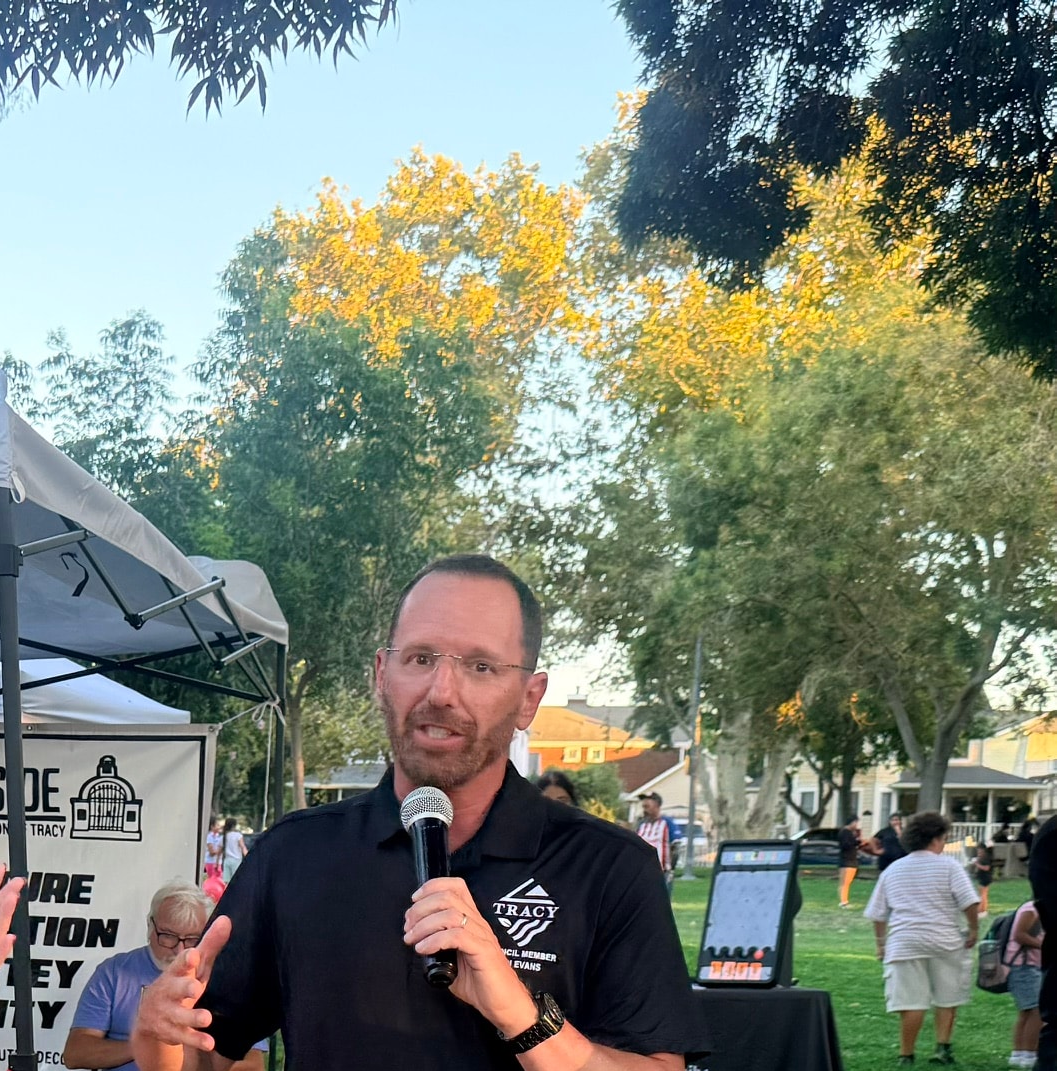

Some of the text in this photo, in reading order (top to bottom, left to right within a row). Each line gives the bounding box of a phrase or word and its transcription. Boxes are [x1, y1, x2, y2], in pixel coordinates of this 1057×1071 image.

[30, 823, 65, 838] TRACY
[492, 902, 560, 919] TRACY
[521, 950, 557, 963] MEMBER
[513, 960, 542, 972] EVANS
